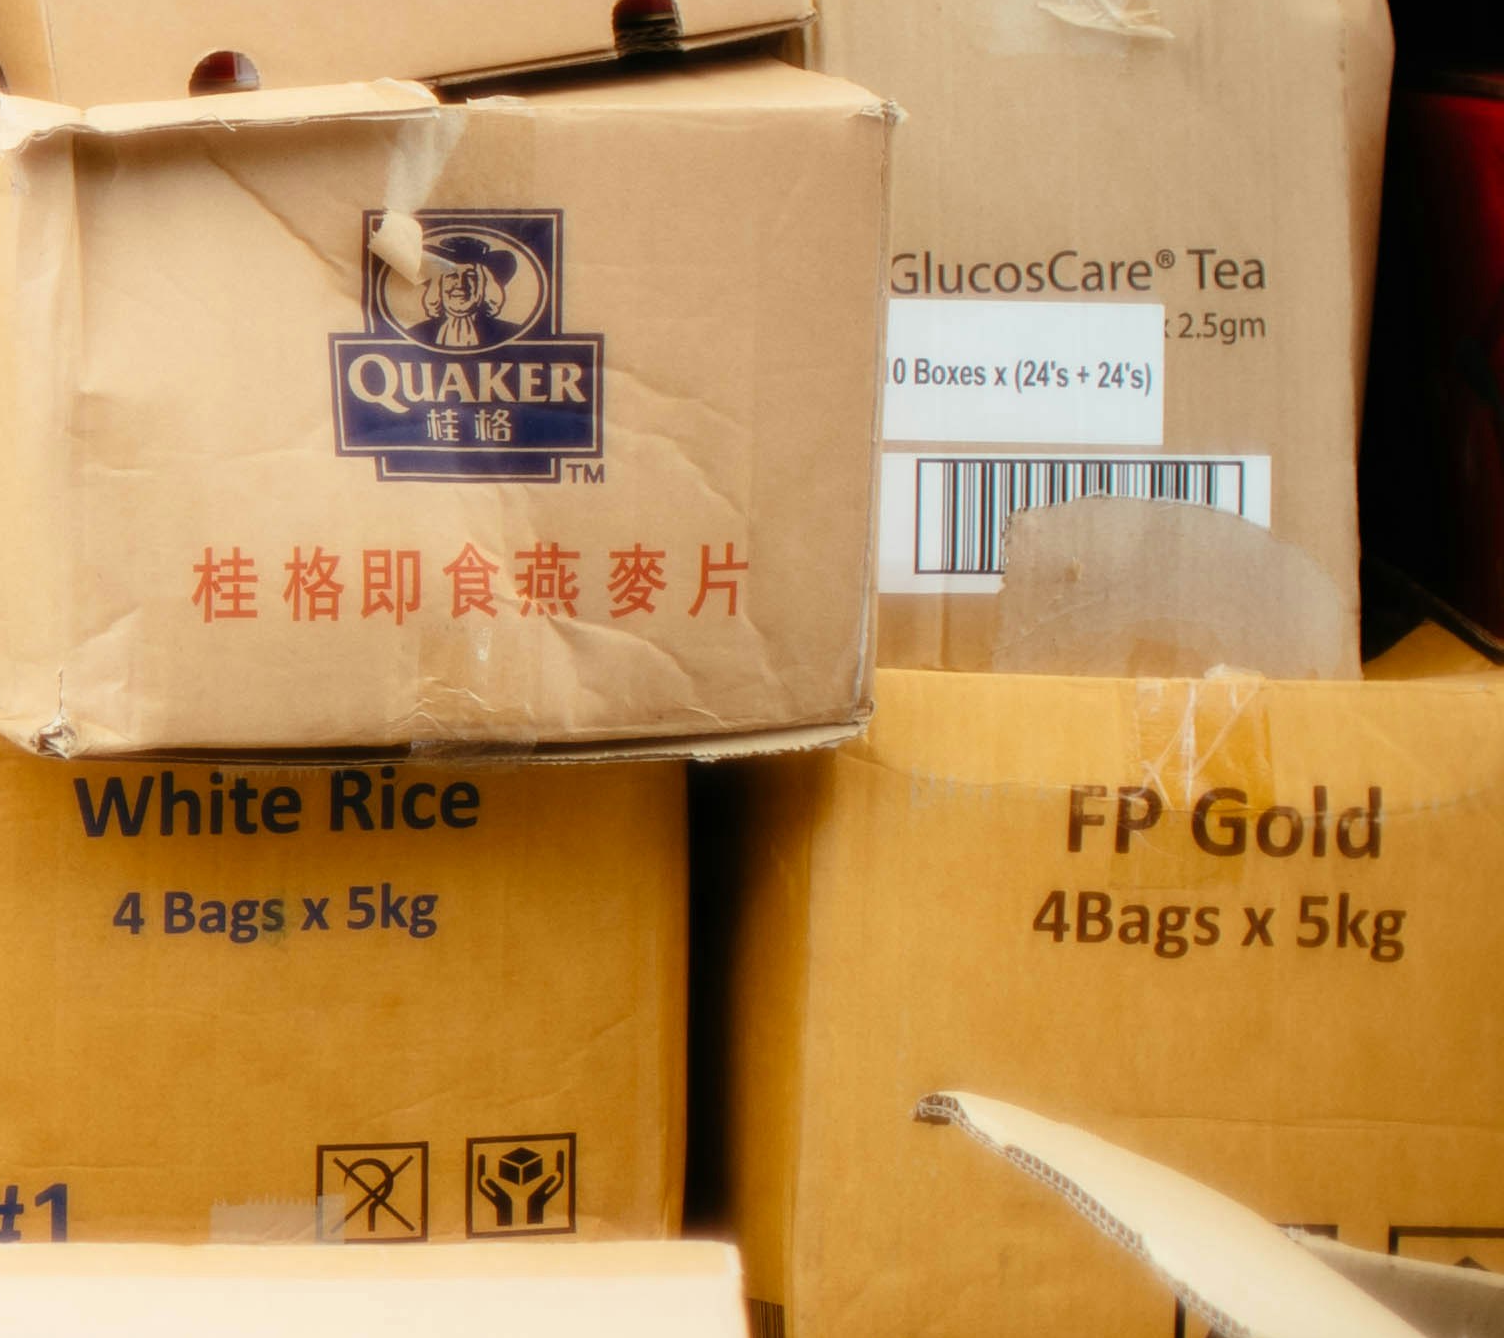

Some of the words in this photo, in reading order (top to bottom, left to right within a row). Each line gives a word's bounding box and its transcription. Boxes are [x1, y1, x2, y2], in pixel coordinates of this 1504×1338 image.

[1185, 247, 1268, 292] Tea
[1177, 310, 1268, 344] 2.5gm
[346, 351, 589, 415] QUAKER
[913, 357, 988, 389] Boxes
[191, 541, 750, 627] 桂格即食燕麥片
[73, 770, 303, 839] White
[328, 766, 483, 833] Rice
[1065, 783, 1167, 856] FP
[1189, 783, 1384, 861] Gold
[112, 892, 146, 936] 4
[163, 889, 287, 945] Bags
[346, 884, 439, 939] 5kg
[1032, 889, 1222, 961] 4Bags
[1295, 893, 1408, 963] 5kg
